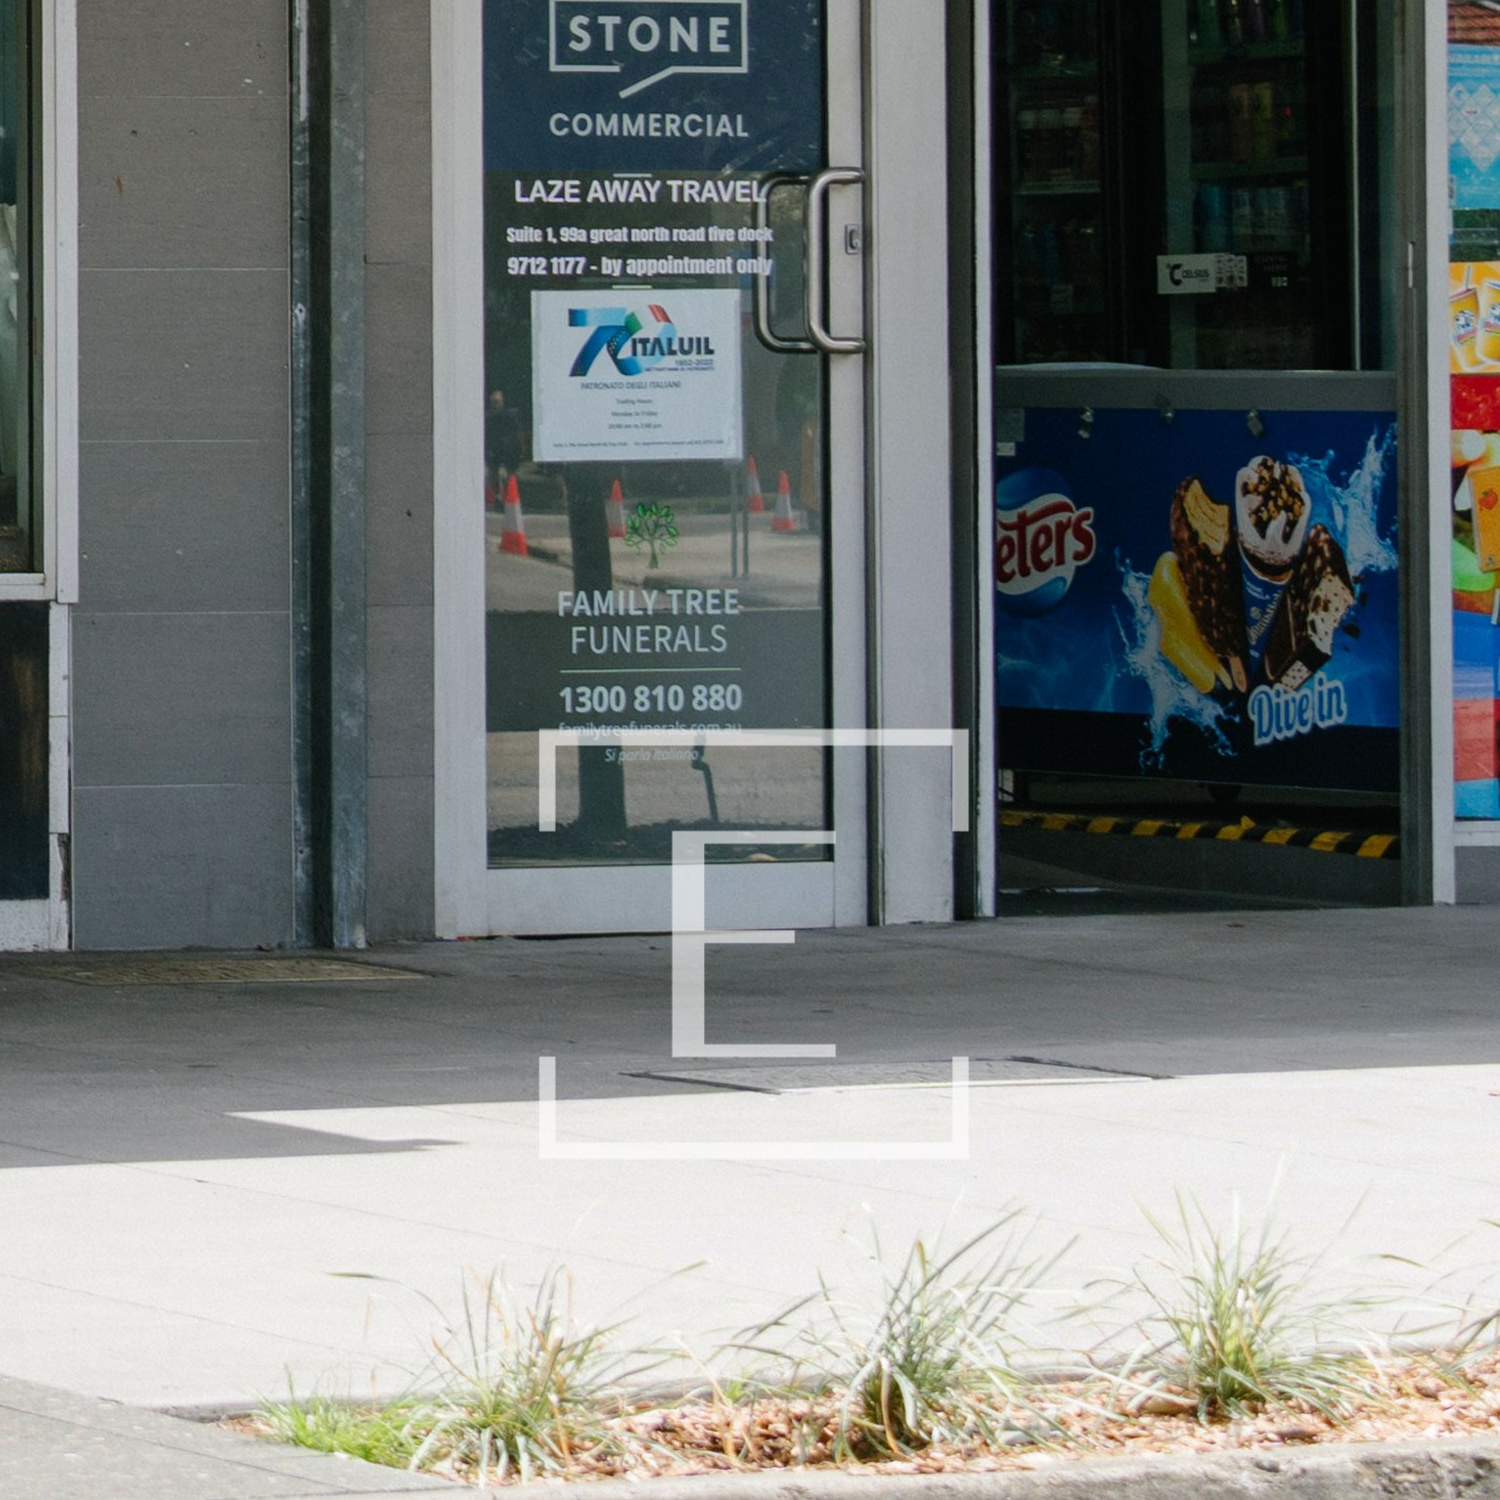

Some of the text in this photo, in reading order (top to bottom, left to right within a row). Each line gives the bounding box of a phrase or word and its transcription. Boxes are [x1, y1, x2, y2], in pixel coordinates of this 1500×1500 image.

[568, 15, 731, 53] STONE
[549, 112, 749, 139] COMMERCIAL
[514, 180, 766, 203] LAZE AWAY TRAVEL
[506, 226, 542, 244] Suite
[560, 226, 587, 243] 99a
[590, 227, 629, 245] great
[631, 226, 669, 243] north
[672, 226, 708, 243] road
[708, 226, 734, 243] five
[738, 226, 774, 243] dock
[507, 256, 773, 277] 9712 1177 by appointment only
[631, 337, 716, 358] ITALUIL
[558, 589, 741, 617] FAMILY TREE
[571, 624, 728, 655] FUNERALS
[559, 684, 742, 714] 1300 810 880
[1249, 671, 1347, 746] Dive in
